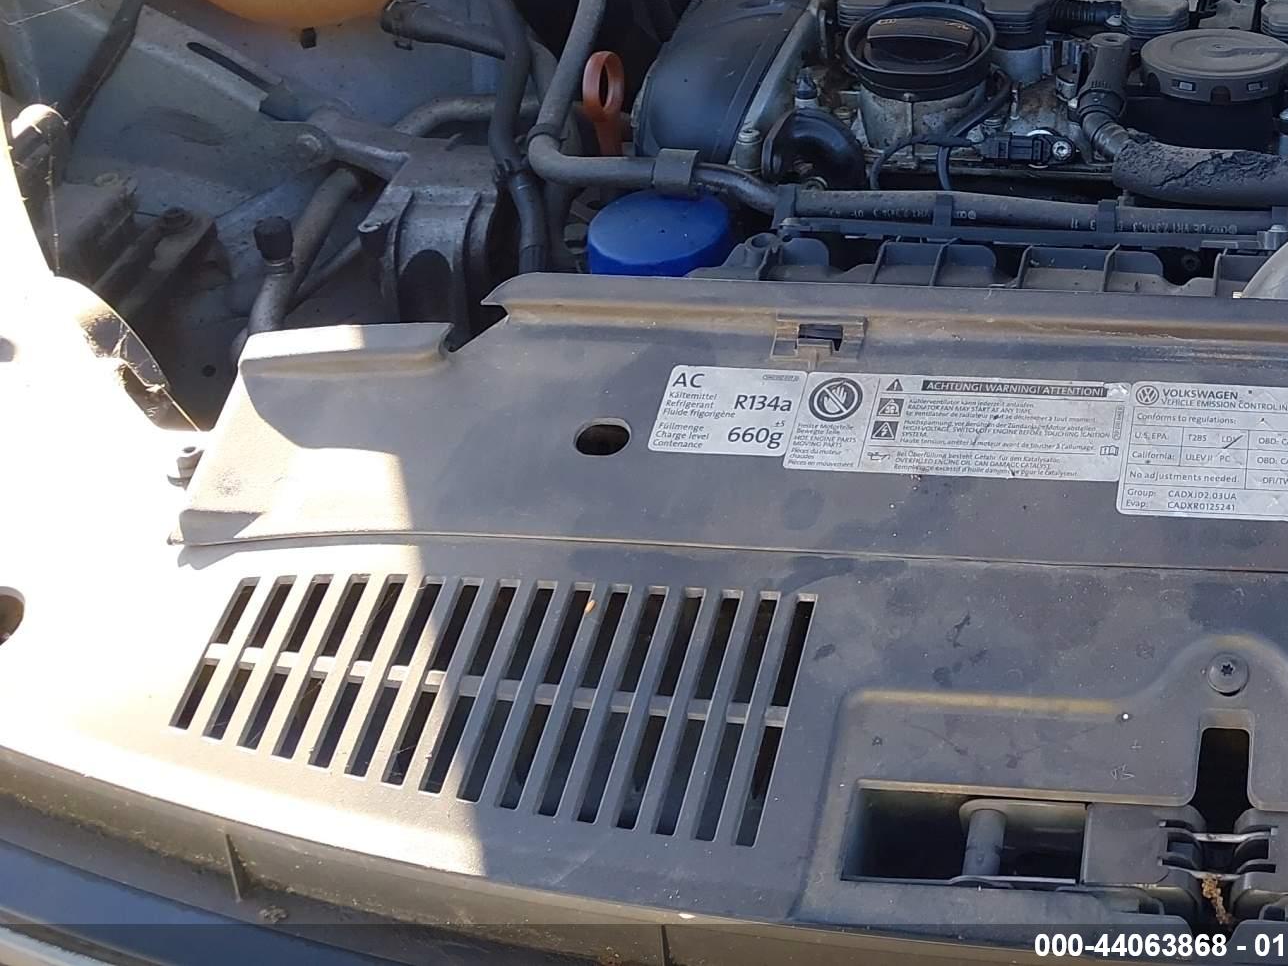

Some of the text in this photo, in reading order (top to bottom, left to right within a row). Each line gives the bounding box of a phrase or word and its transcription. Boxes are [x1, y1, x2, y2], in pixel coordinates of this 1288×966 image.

[673, 373, 704, 388] AC
[926, 382, 1104, 397] ACHTUNG! WARNING! ATTENTION!
[1163, 389, 1238, 399] VOLKSWAGEN
[666, 400, 714, 409] Refrigerant
[734, 395, 792, 411] R134a
[1161, 398, 1193, 407] VEHICLE
[1197, 400, 1237, 409] EMISSION
[1238, 402, 1279, 411] CONTROL
[690, 410, 736, 419] frigorigène
[1137, 413, 1176, 421] Conforms
[1189, 416, 1237, 425] regulations:
[658, 422, 704, 431] Füllmenge
[655, 430, 709, 440] Charge level
[727, 427, 784, 449] 660g
[653, 439, 702, 448] Contenance
[1131, 451, 1175, 460] California:
[1257, 457, 1277, 465] OBD:
[1144, 472, 1201, 482] adjustments
[1204, 475, 1239, 483] needed.
[1127, 489, 1237, 500] Group: CADXJ02.03UA
[1167, 501, 1235, 511] CADXR0125241
